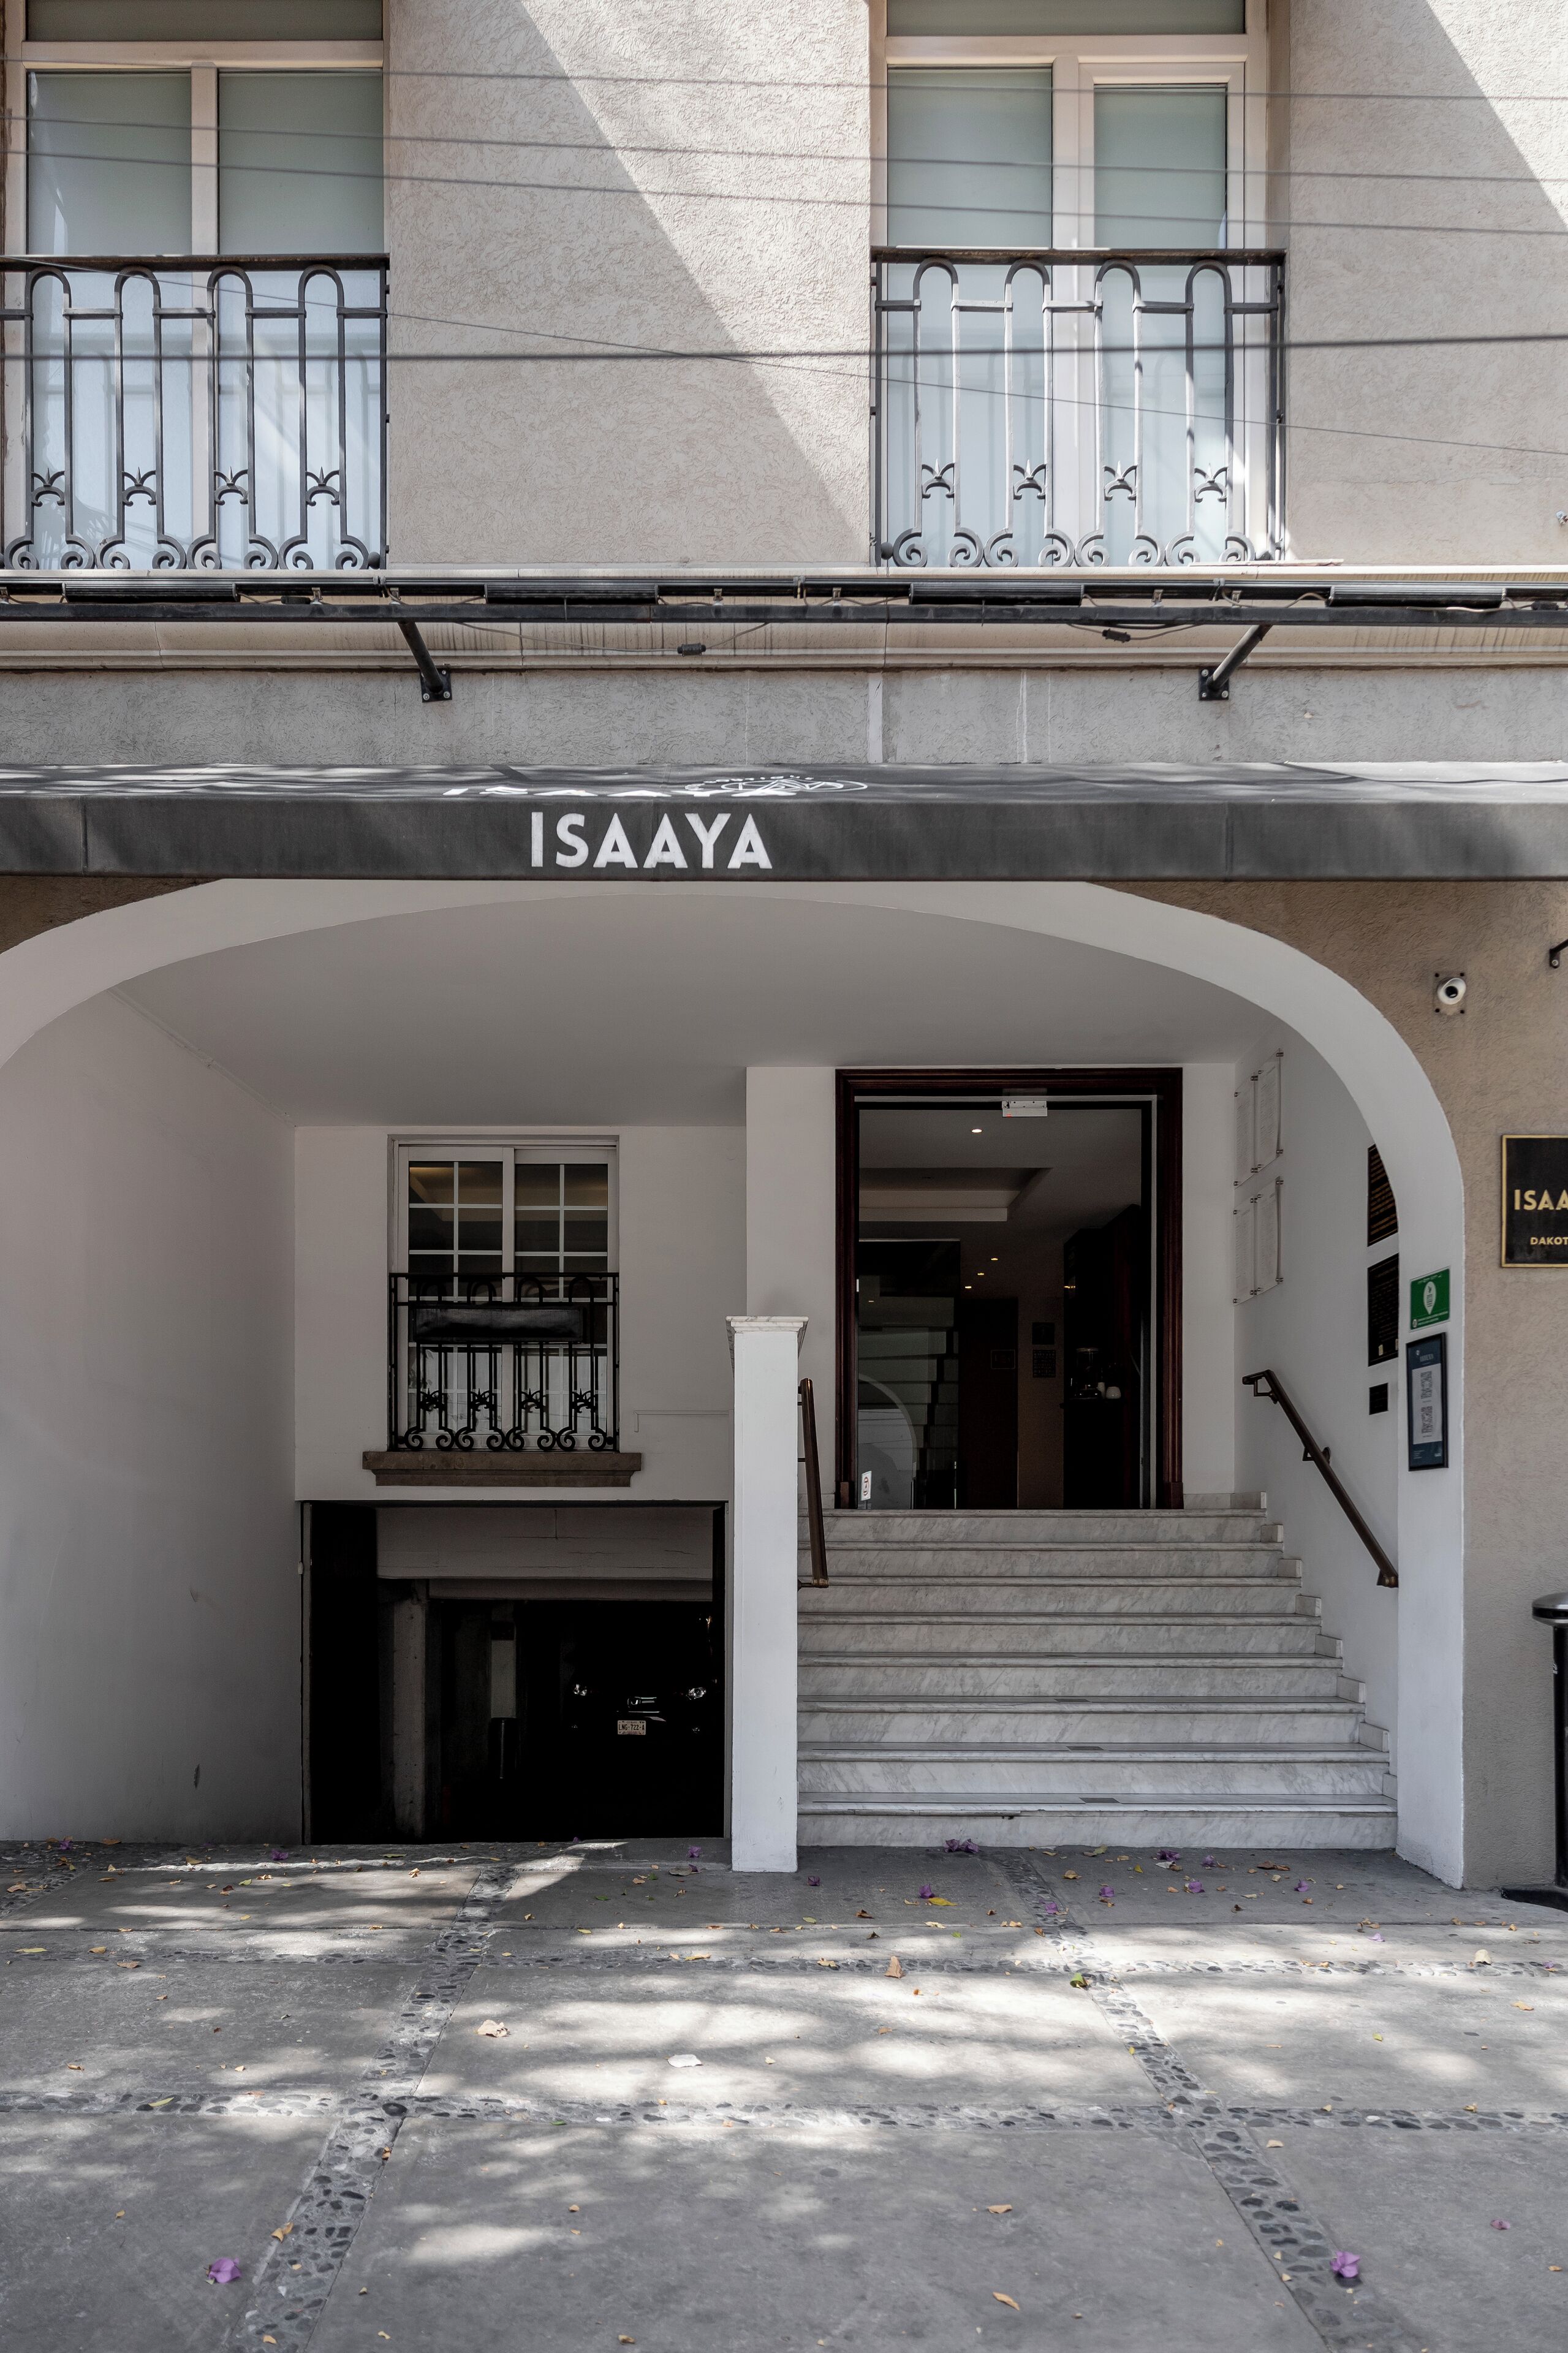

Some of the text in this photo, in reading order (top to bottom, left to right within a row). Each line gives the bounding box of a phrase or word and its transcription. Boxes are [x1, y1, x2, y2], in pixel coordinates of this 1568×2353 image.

[442, 787, 797, 797] ISAAYA
[531, 812, 773, 869] ISAAYA
[1514, 1189, 1568, 1210] ISAA
